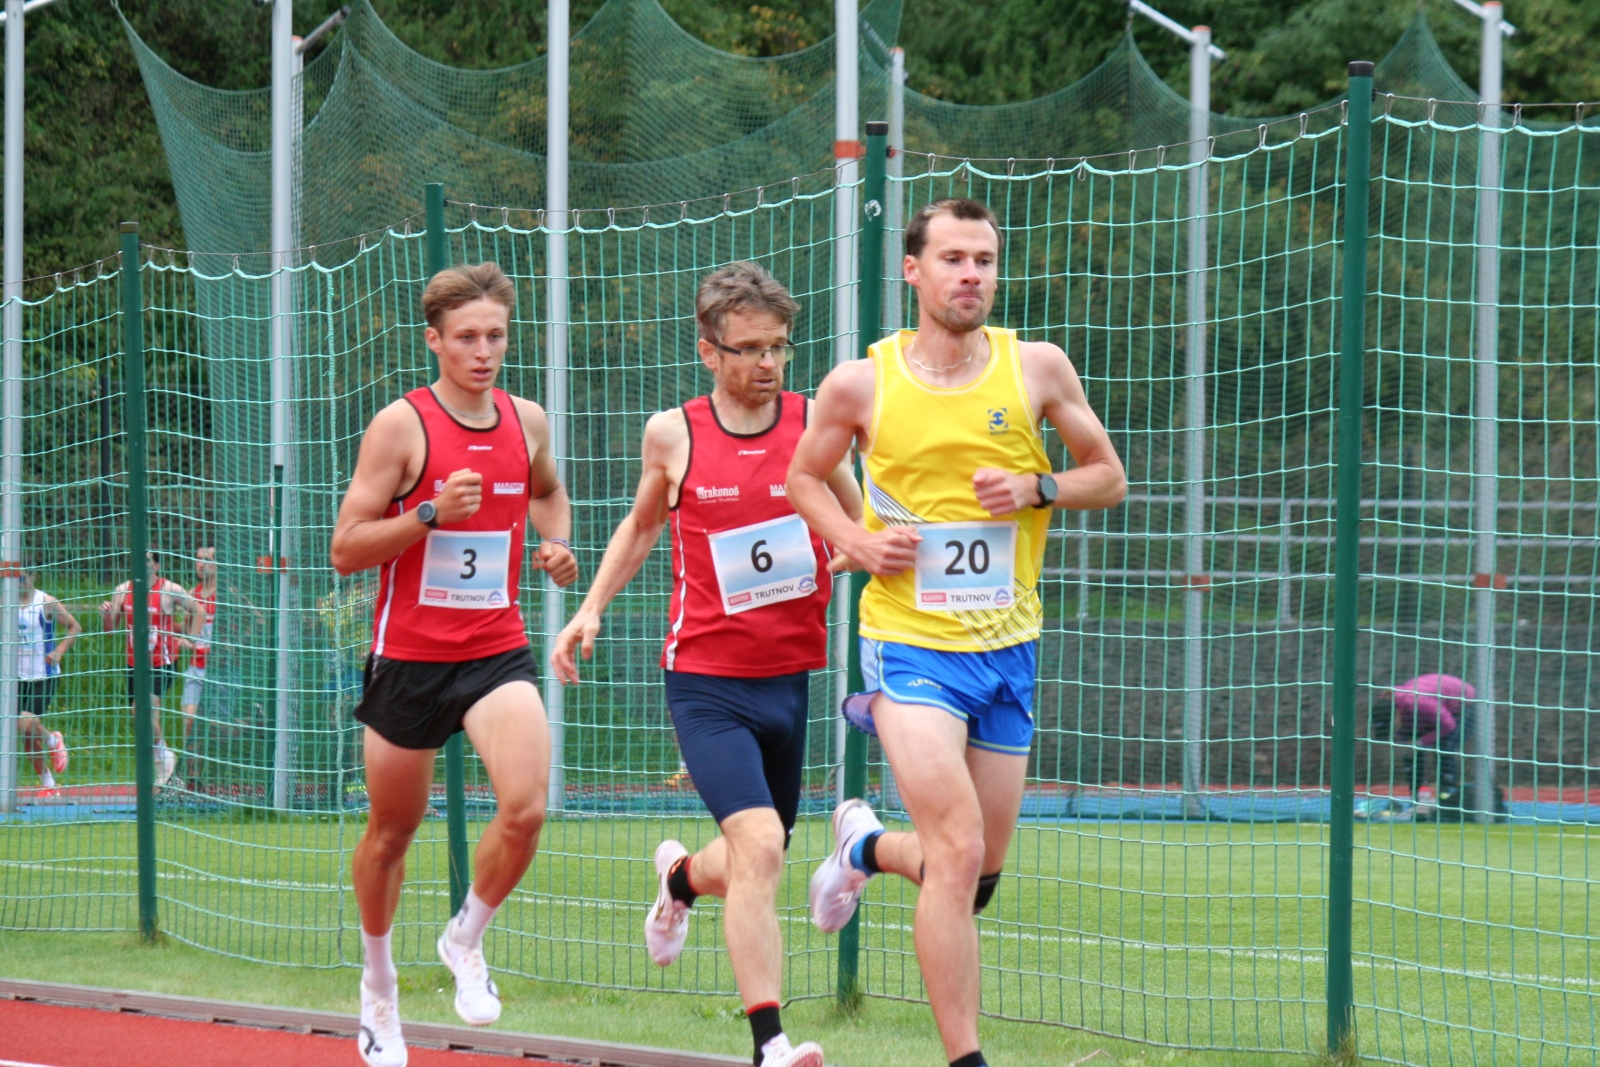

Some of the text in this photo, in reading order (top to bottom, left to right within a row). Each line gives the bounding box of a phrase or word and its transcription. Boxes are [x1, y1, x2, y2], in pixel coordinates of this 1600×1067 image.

[460, 548, 477, 580] 3
[750, 539, 773, 573] 6
[945, 539, 990, 575] 20
[451, 593, 487, 602] TRUTNOV
[755, 584, 794, 600] TRUTNOV
[950, 593, 992, 602] TRUTNOV
